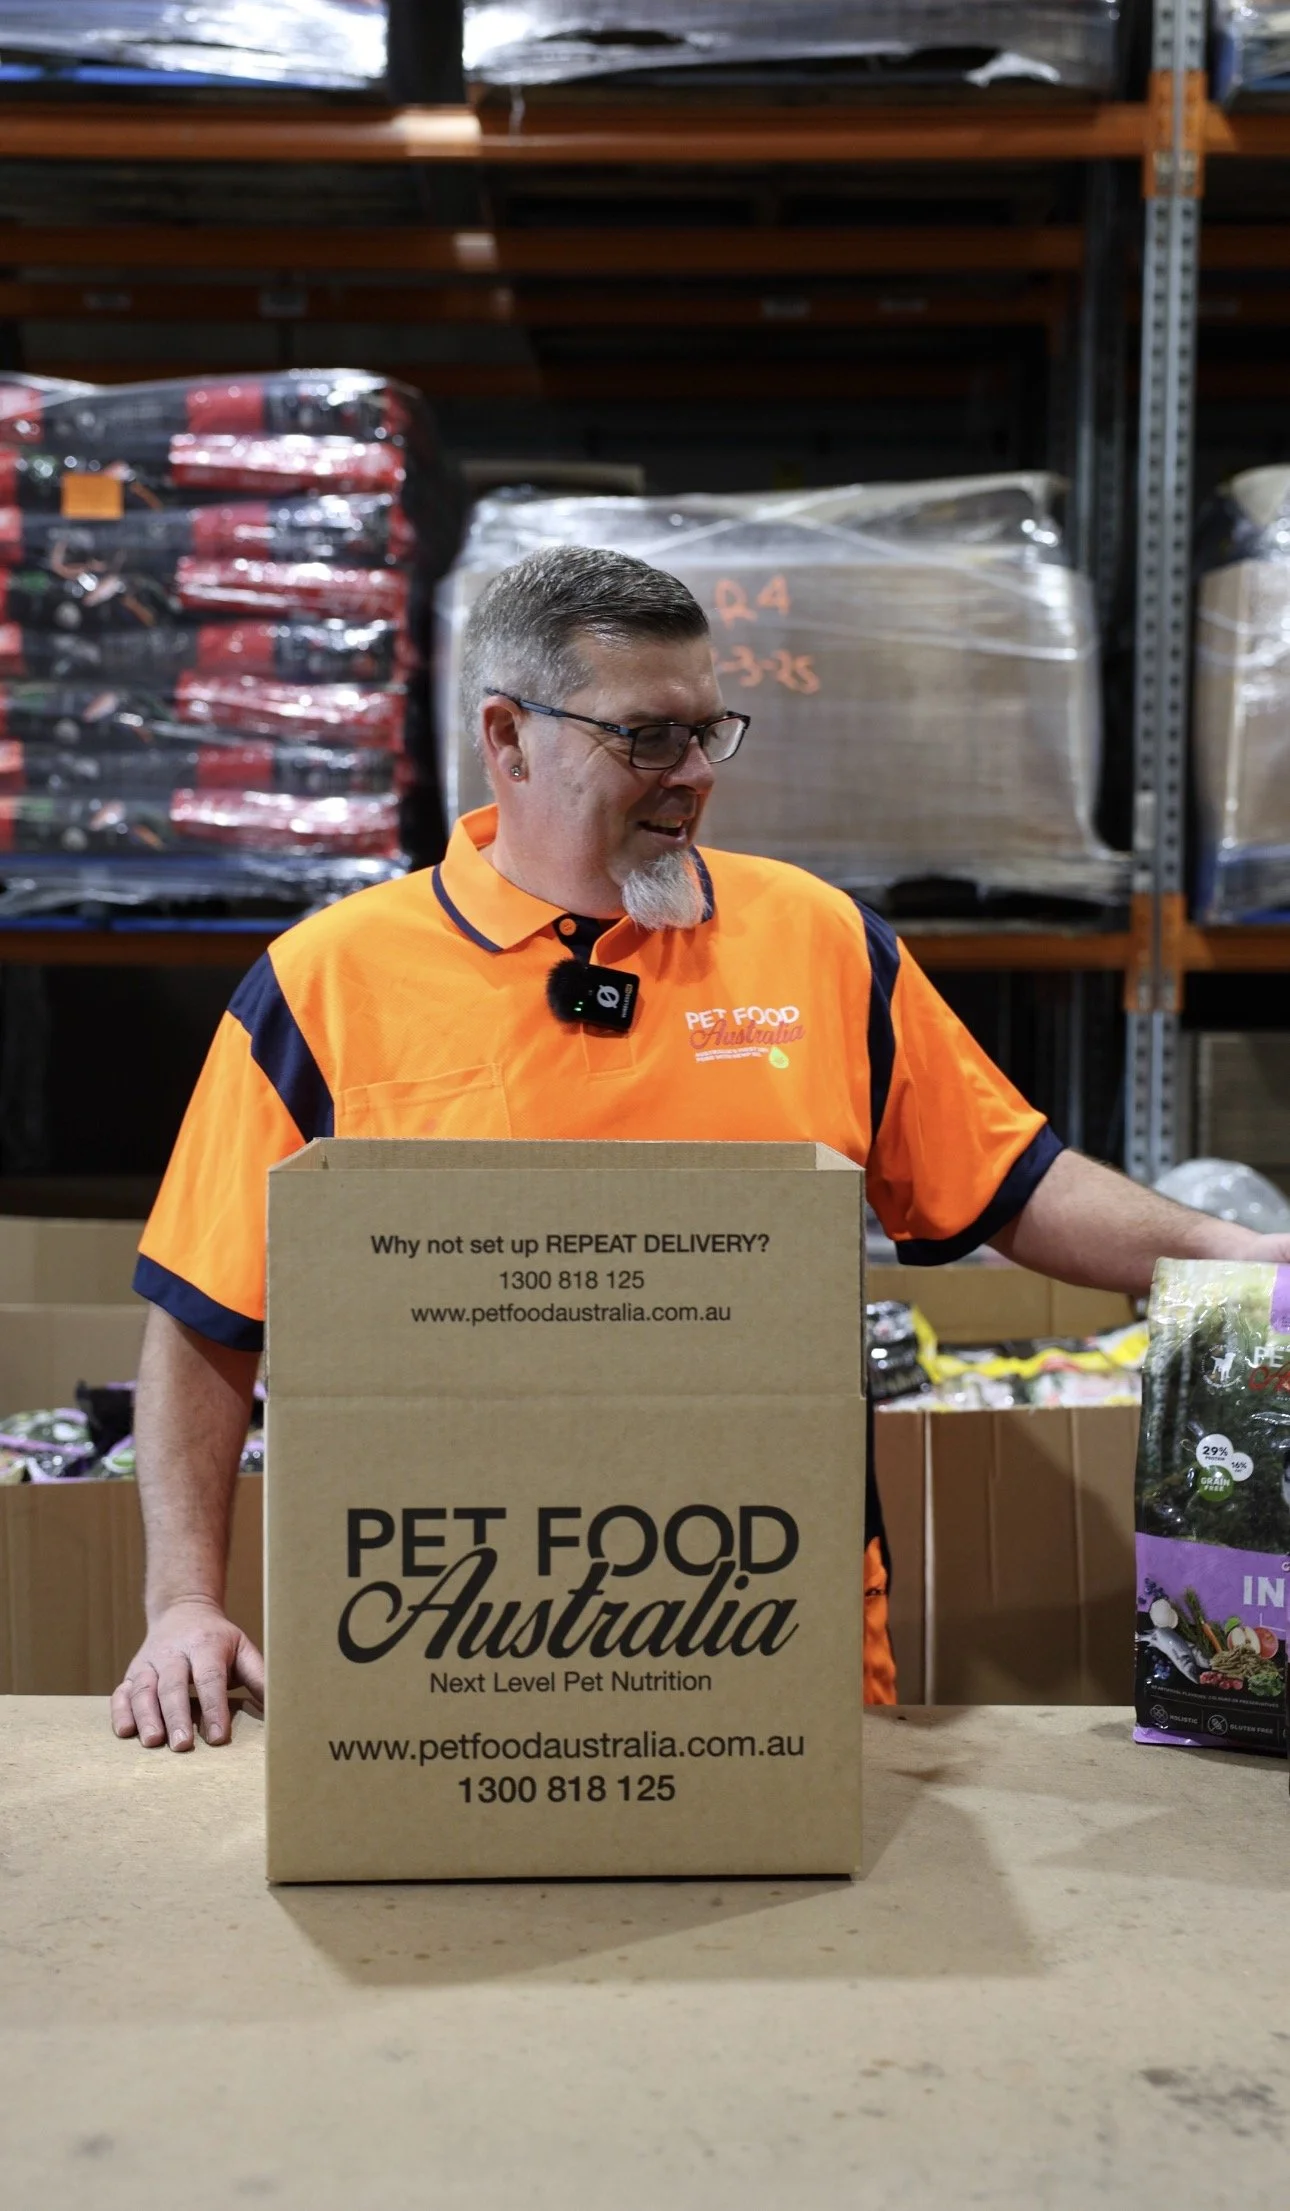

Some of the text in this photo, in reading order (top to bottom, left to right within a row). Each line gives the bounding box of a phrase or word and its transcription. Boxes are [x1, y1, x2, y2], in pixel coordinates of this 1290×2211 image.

[684, 1005, 800, 1030] PET FOOD
[689, 1019, 806, 1049] Australia
[370, 1233, 770, 1258] Why not set up REPEAT DELIVERY?
[499, 1270, 645, 1290] 1300 818 125
[411, 1302, 732, 1324] www.petfoodaustralia.com.au
[1253, 1345, 1290, 1368] PE
[1202, 1446, 1228, 1456] 29%
[1200, 1477, 1230, 1487] GRAIN
[1204, 1484, 1224, 1492] FREE
[347, 1504, 800, 1578] PET FOOD
[337, 1546, 801, 1664] Australia
[430, 1670, 712, 1693] Next Level Pet Nutrition
[1229, 1723, 1274, 1735] GLUTEN FREE
[328, 1730, 805, 1767] www.petfoodaustralia.com.au
[458, 1774, 676, 1804] 1300 818 125
